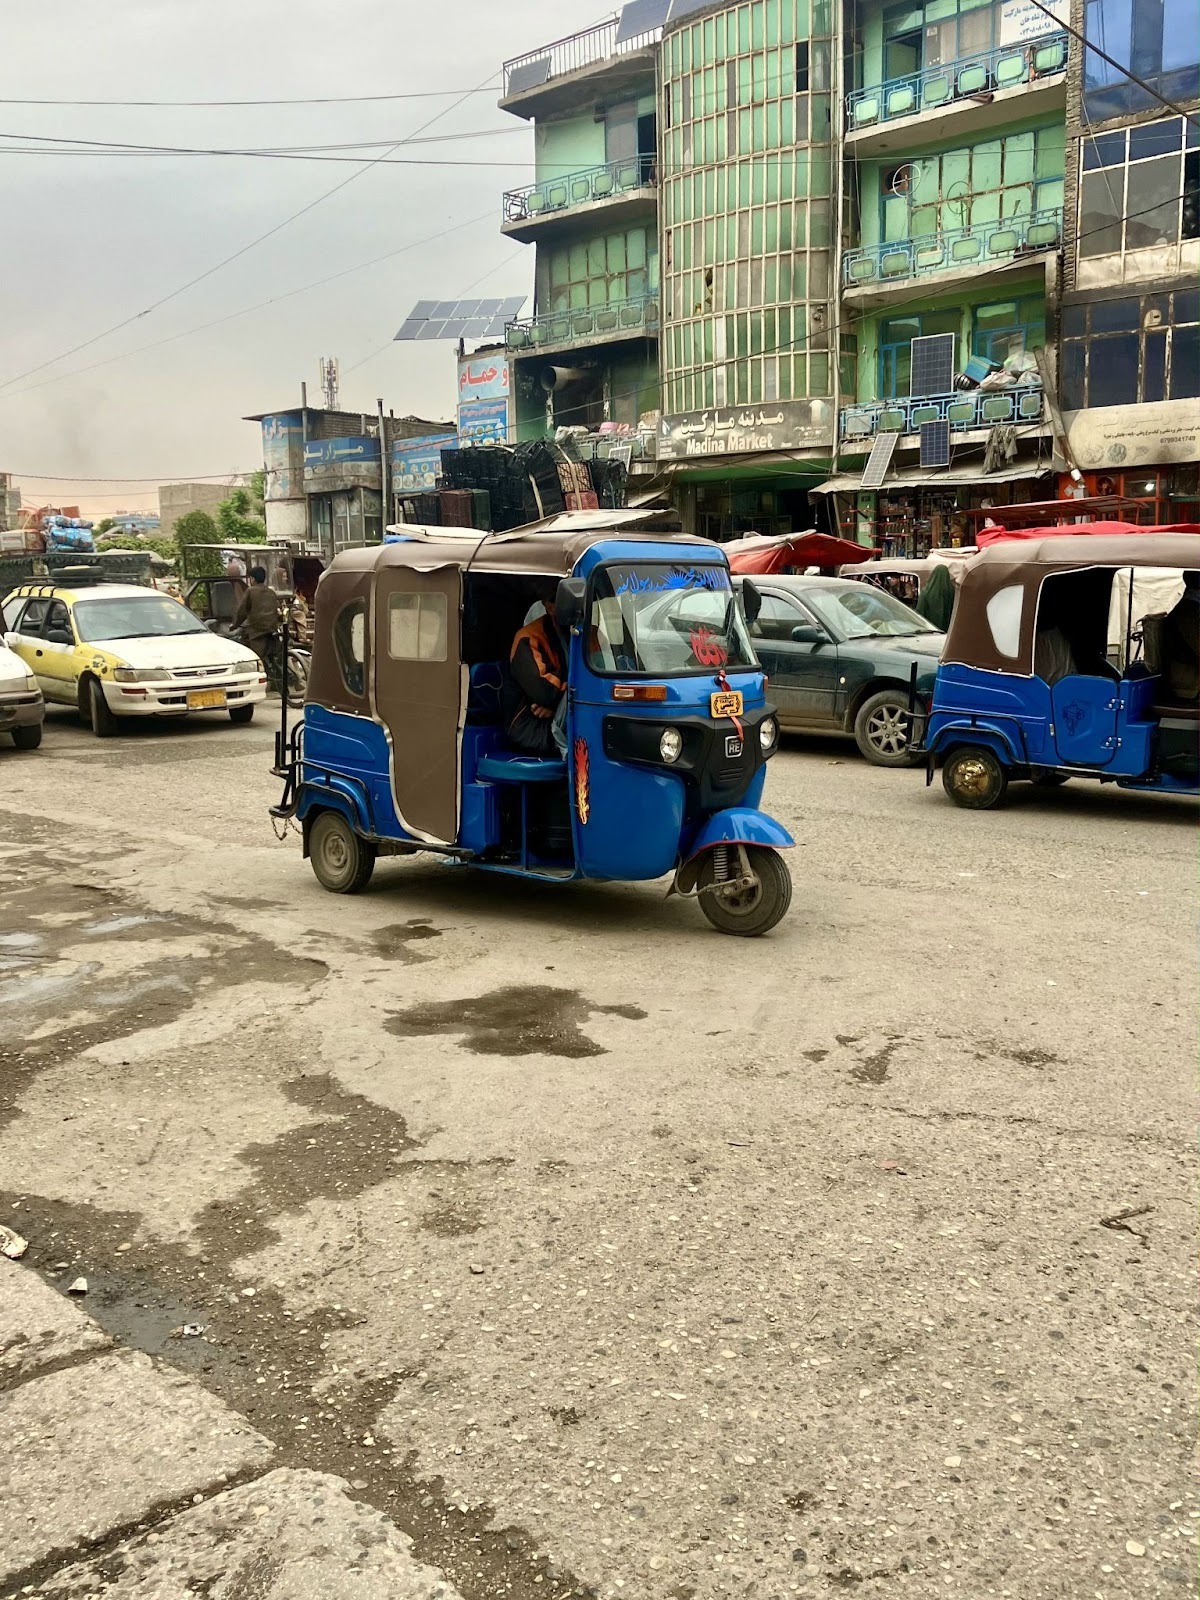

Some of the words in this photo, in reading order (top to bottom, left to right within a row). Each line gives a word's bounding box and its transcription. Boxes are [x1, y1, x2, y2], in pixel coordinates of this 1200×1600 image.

[460, 365, 498, 392] حمام
[681, 411, 736, 437] مارکیت
[738, 410, 785, 431] مدینه
[326, 443, 365, 460] مزار
[686, 435, 726, 456] Madina
[727, 432, 774, 452] Market
[729, 743, 740, 754] RE
